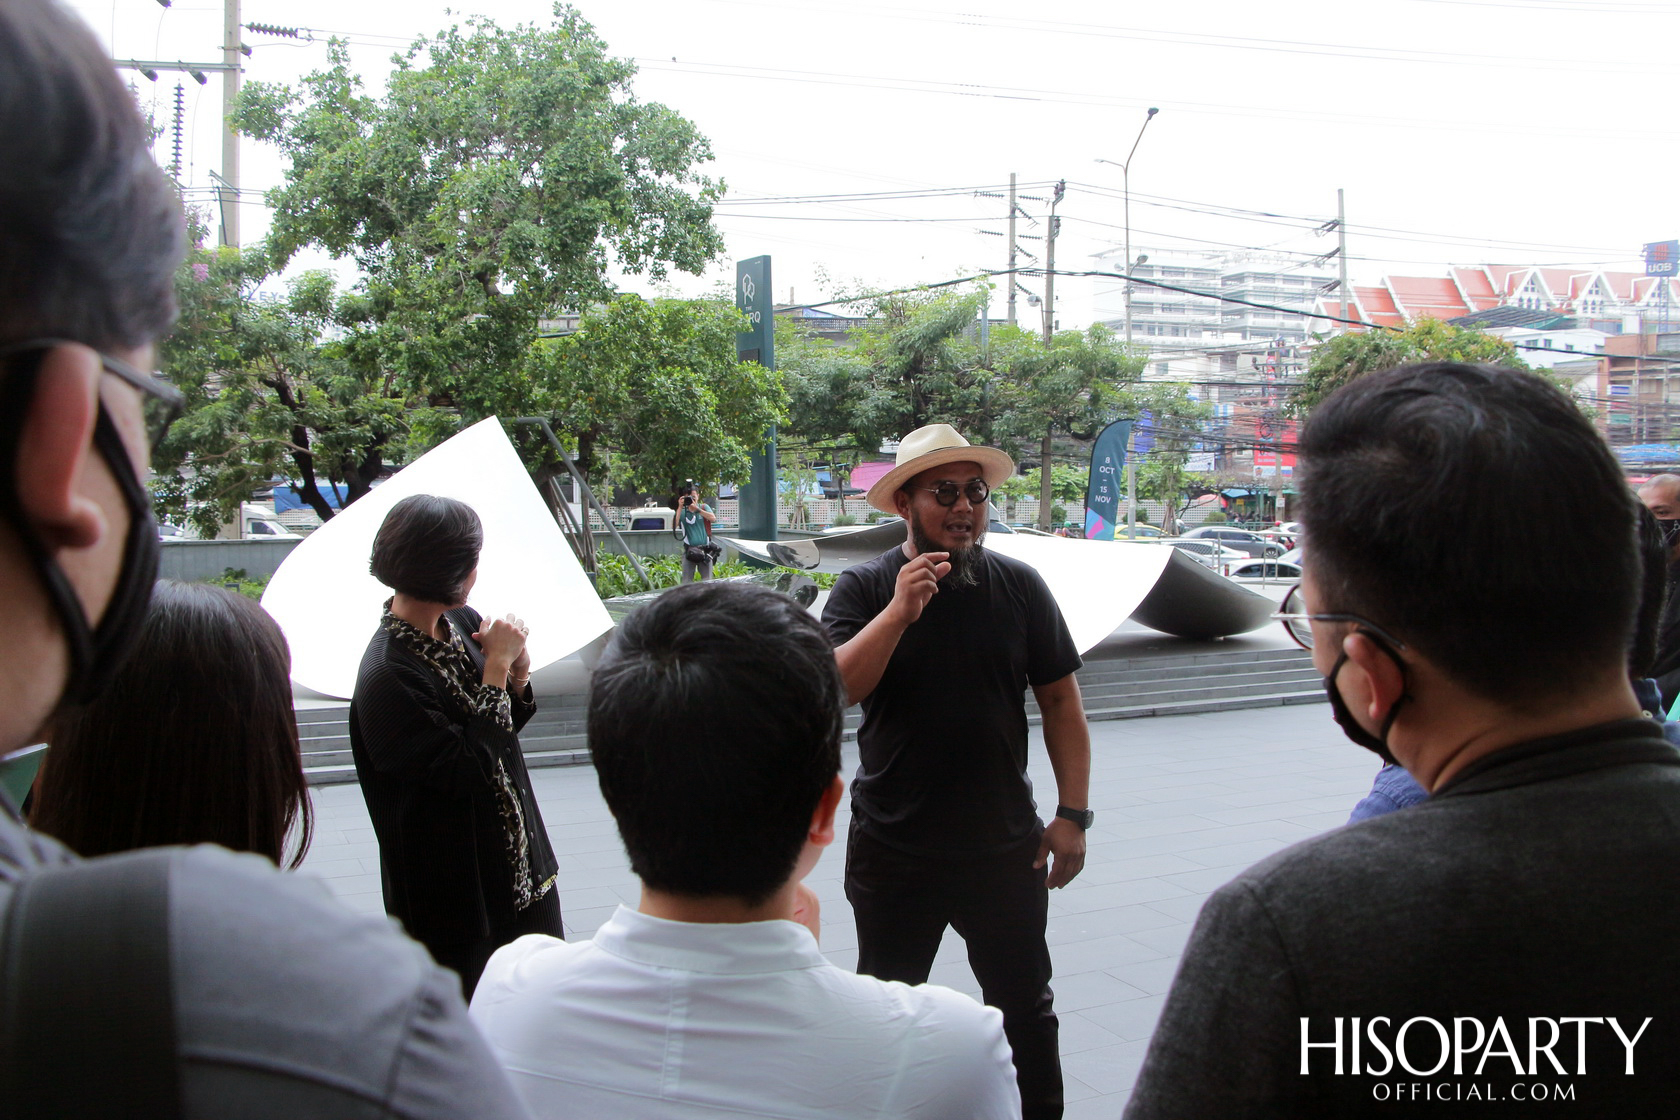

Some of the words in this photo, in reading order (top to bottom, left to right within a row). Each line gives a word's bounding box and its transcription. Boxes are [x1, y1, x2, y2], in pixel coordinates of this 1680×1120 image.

[1647, 262, 1673, 273] UOB
[1104, 456, 1111, 464] 8
[1099, 465, 1116, 475] OCT
[1099, 485, 1108, 493] 15
[1094, 494, 1112, 504] NOV
